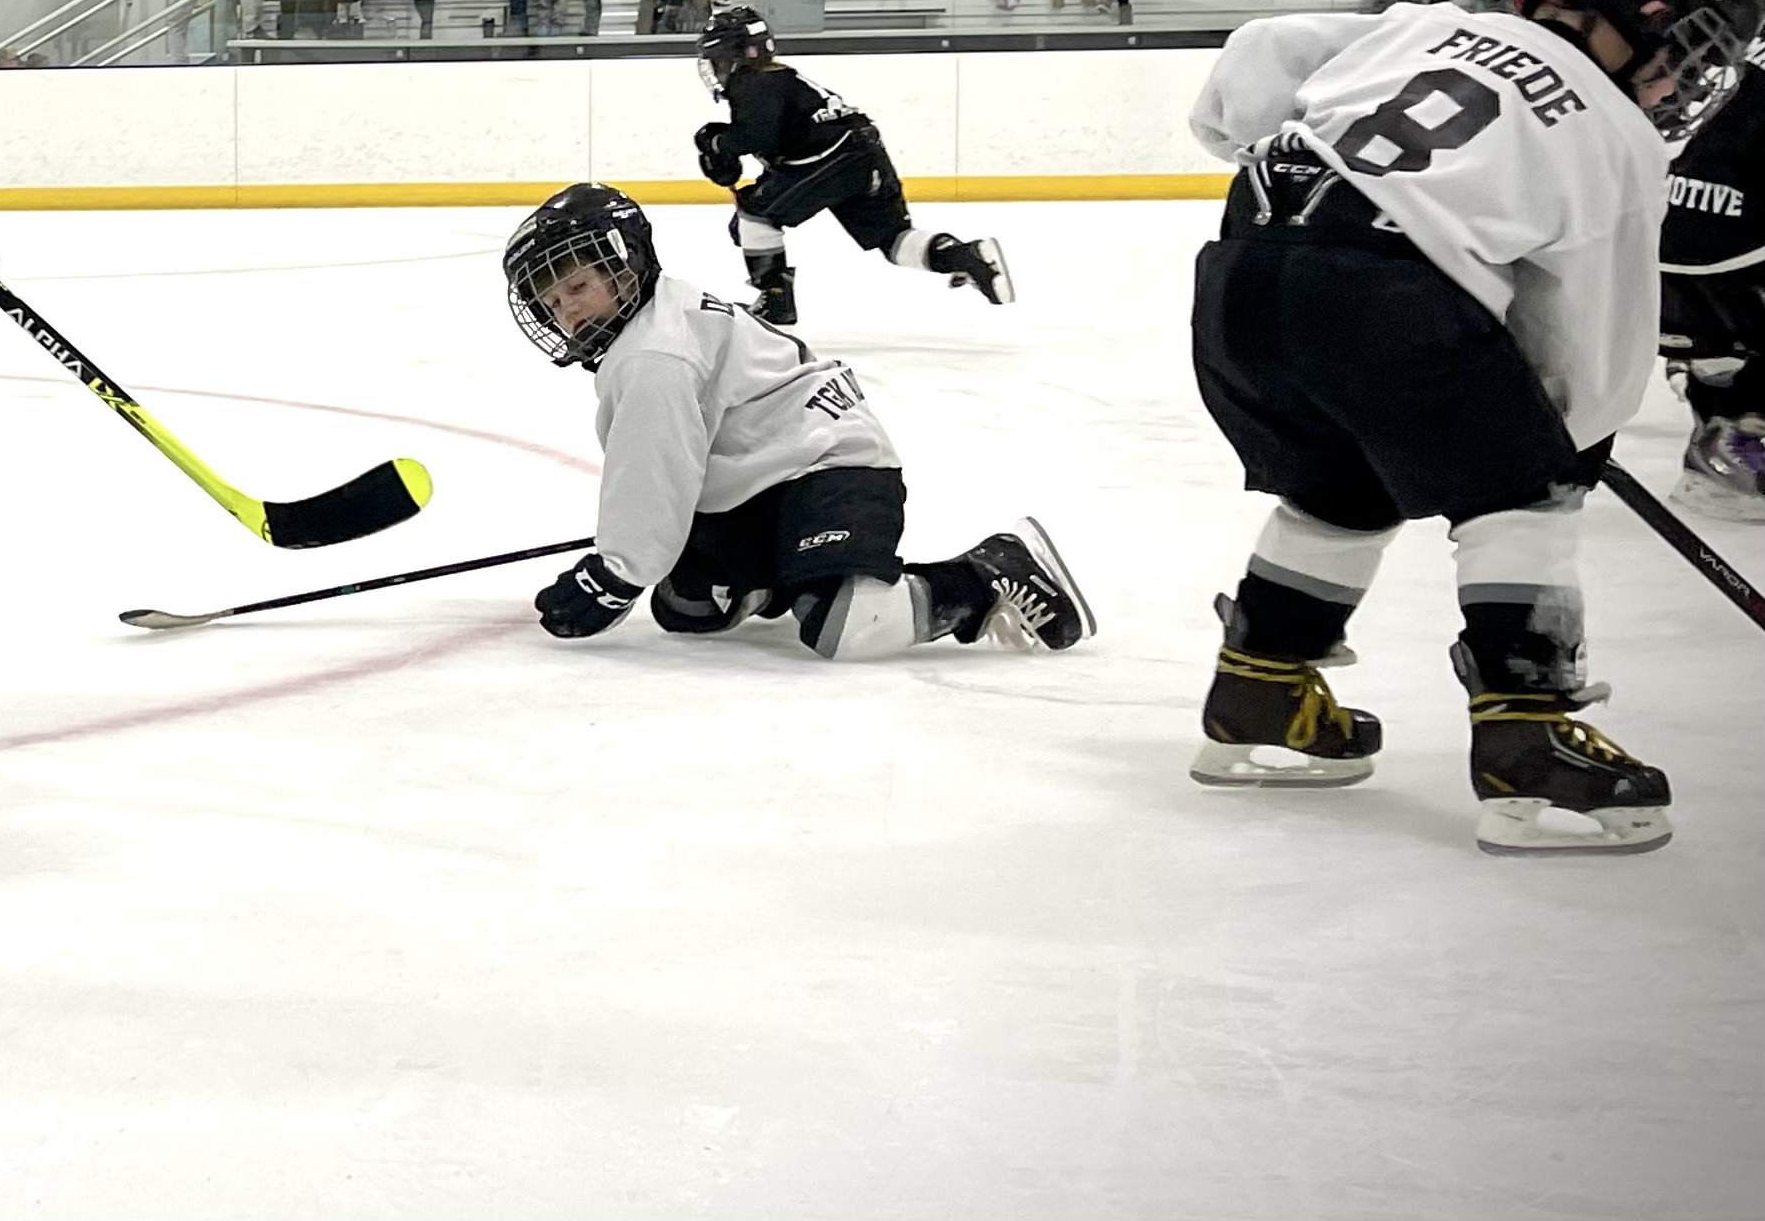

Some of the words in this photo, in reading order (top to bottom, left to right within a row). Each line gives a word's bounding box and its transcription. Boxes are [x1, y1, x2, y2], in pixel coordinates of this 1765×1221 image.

[1427, 28, 1588, 128] FRIEDE
[1334, 68, 1501, 177] 8
[1667, 173, 1745, 217] OTIVE
[6, 307, 83, 379] ALPHA
